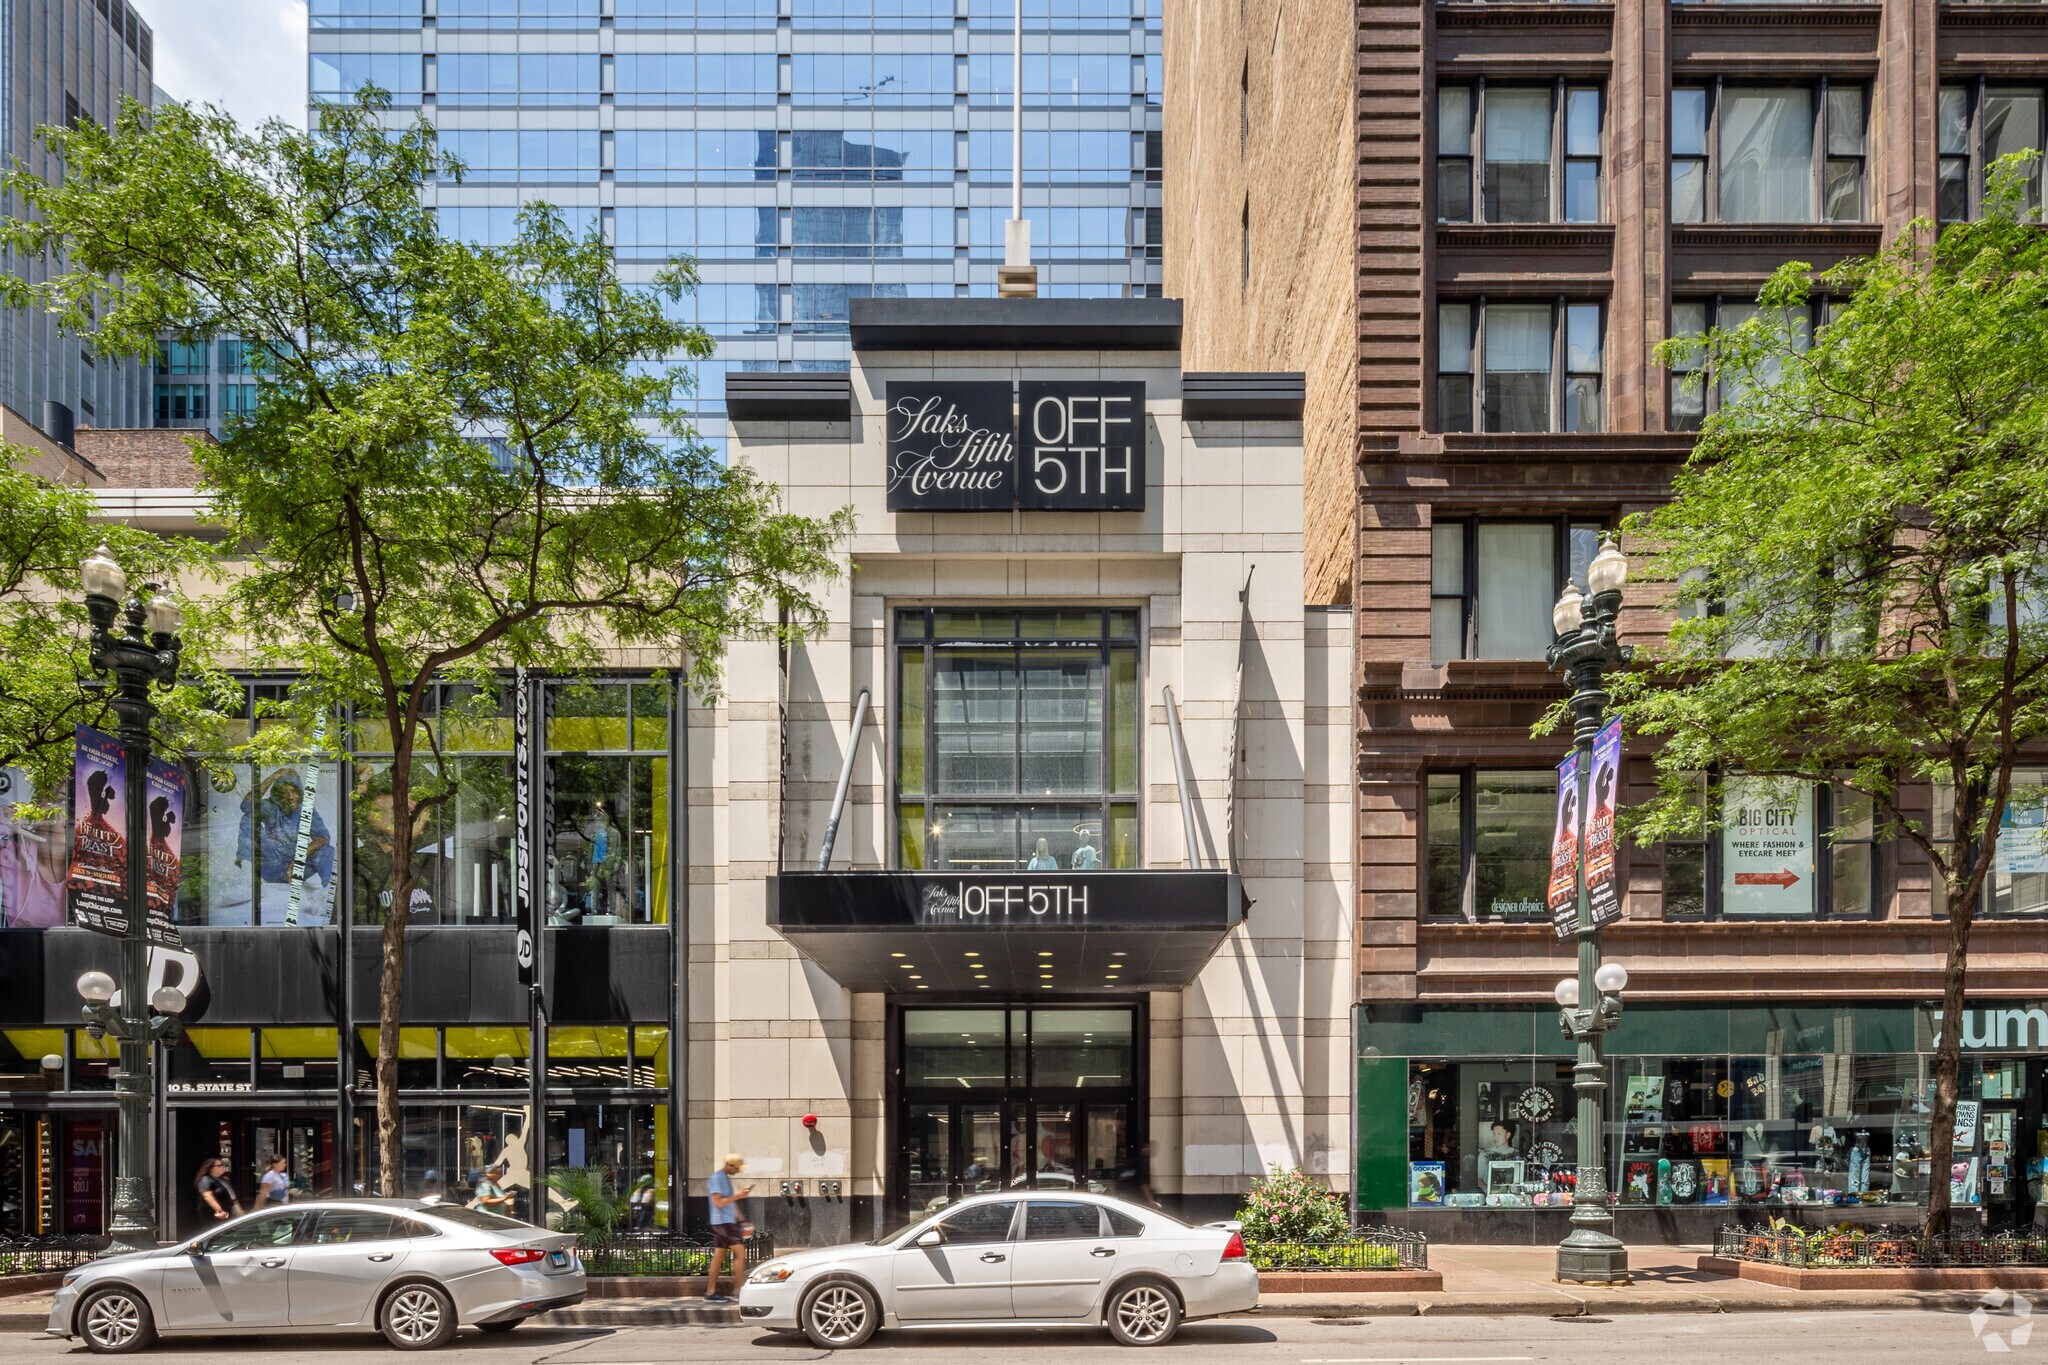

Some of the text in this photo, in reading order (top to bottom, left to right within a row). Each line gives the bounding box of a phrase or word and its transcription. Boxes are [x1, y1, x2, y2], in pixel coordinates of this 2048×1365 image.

[886, 395, 968, 442] Saks
[1033, 396, 1131, 444] OFF
[930, 425, 1014, 469] Fifth
[887, 451, 1003, 496] Avenue
[1034, 446, 1131, 494] 5TH
[88, 747, 101, 756] OUR
[516, 664, 529, 909] JDSPORTS.COM
[298, 790, 316, 835] CONNECTION
[1739, 809, 1796, 827] BIG CITY
[79, 819, 121, 845] BEAUTY
[1739, 828, 1797, 836] OPTICAL
[78, 835, 123, 858] BEAST
[294, 835, 310, 863] UNLOCK
[1731, 841, 1805, 849] WHERE FASHION &
[1738, 849, 1797, 857] EYECARE MEET
[292, 863, 306, 879] THE
[286, 879, 303, 922] WORLDWIDE
[925, 883, 948, 899] Saks
[965, 885, 1088, 915] OFF 5TH
[76, 898, 123, 915] LoopChicago.com
[1491, 897, 1518, 916] designer
[1518, 896, 1545, 916] off-price
[168, 1083, 252, 1092] 10 S. STATE ST
[1519, 1086, 1555, 1104] AFFLICTION
[1520, 1108, 1533, 1122] LIVE
[1956, 1104, 1976, 1112] RONES
[1957, 1118, 1974, 1127] NGS
